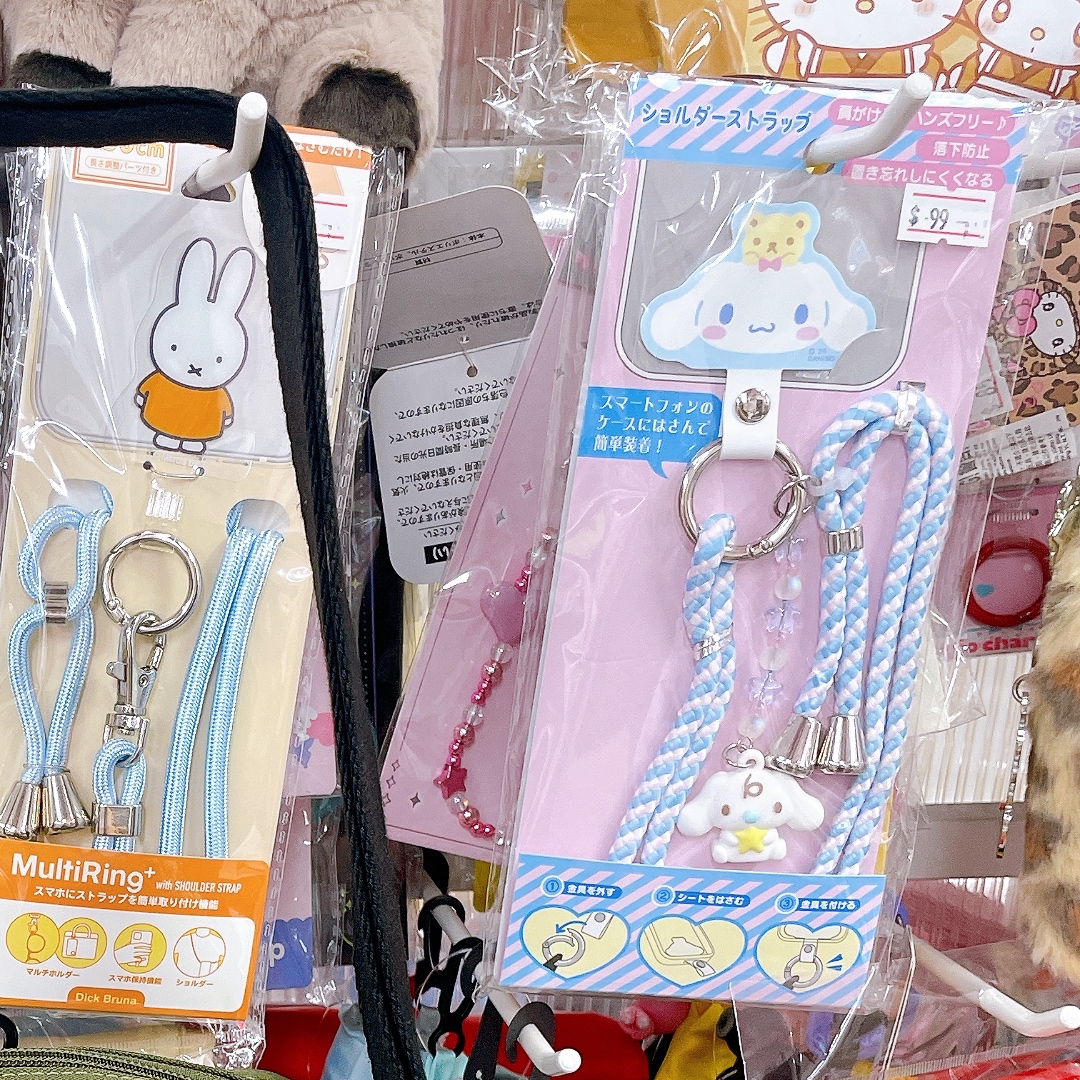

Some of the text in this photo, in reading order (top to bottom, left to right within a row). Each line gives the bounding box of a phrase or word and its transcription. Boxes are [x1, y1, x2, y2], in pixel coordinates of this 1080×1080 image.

[640, 103, 812, 135] ショルダーストラップ
[932, 140, 991, 160] 落下防止
[850, 163, 994, 189] 置き忘れしにくくなる
[600, 394, 713, 416] スマートフォンの
[596, 414, 711, 436] ケースにはさんで
[593, 434, 663, 454] 簡単装着！
[156, 879, 242, 894] with SHOULDER STRAP
[34, 885, 219, 910] スマホにストラップを簡単取り付け機能
[676, 891, 744, 907] シートをはさむ
[26, 968, 80, 979] マルチホルダー
[108, 974, 163, 986] スマホ保持機能
[175, 978, 214, 988] ショルダー
[75, 991, 139, 1006] Dick Bruna
